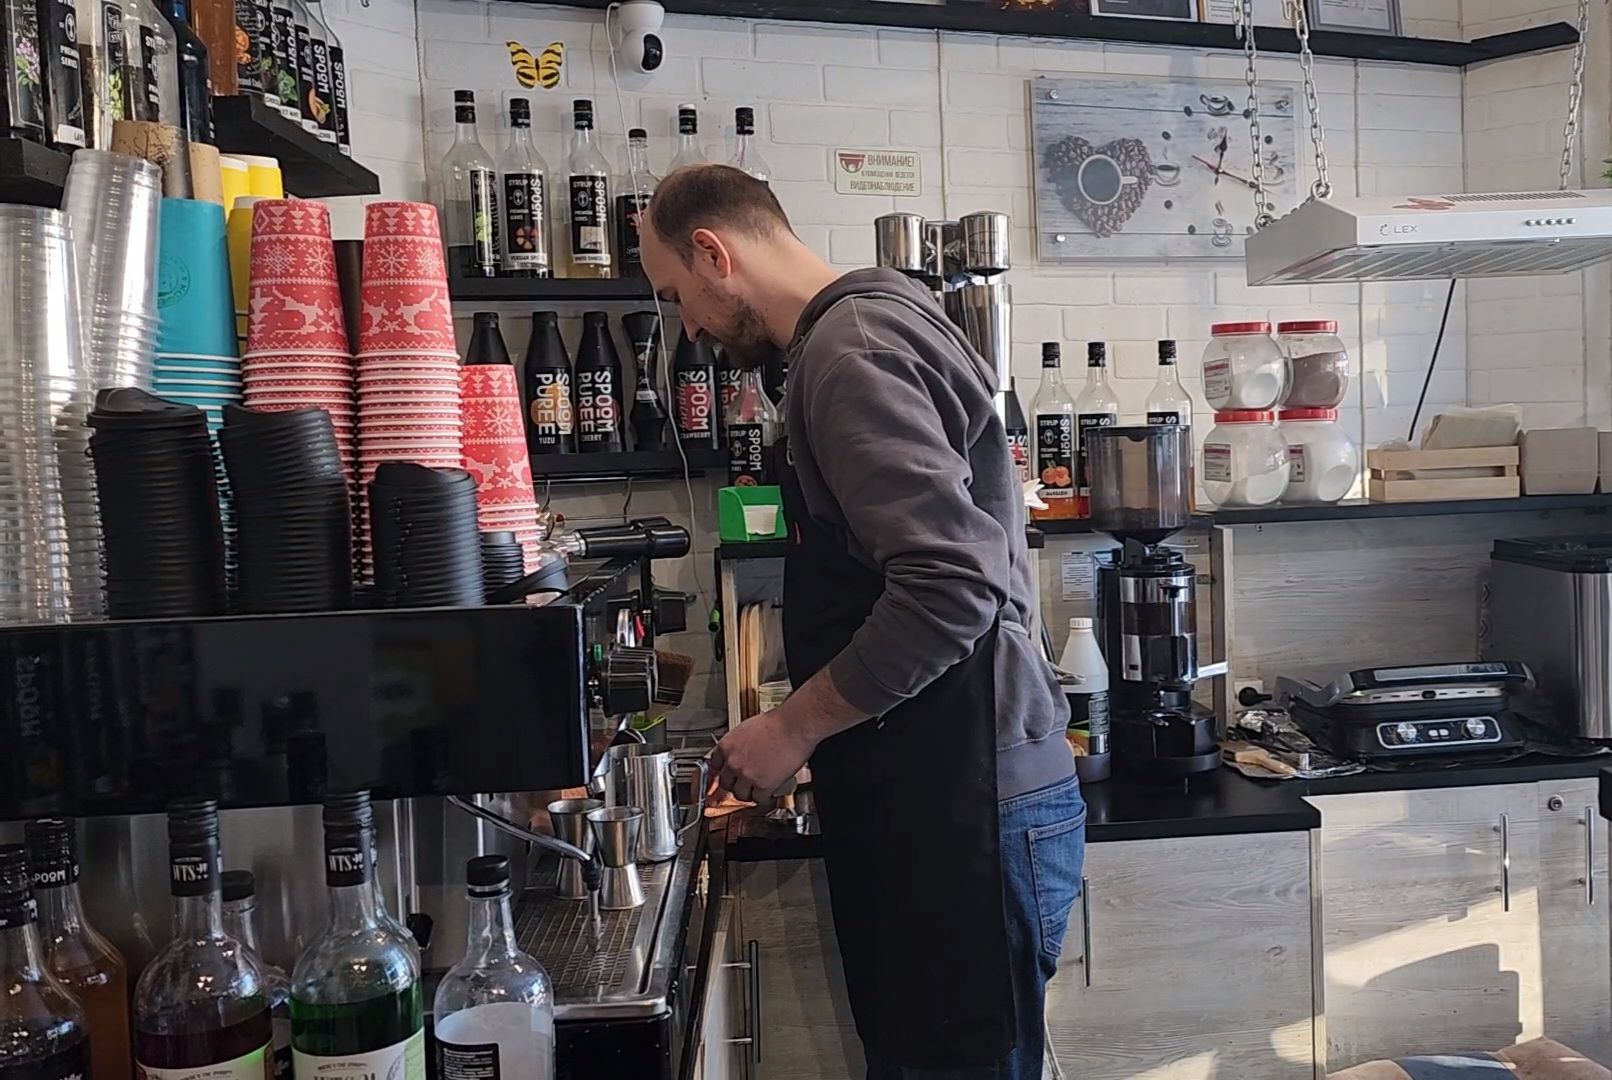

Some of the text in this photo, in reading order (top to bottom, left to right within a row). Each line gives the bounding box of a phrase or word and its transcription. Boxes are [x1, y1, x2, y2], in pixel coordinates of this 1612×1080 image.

[286, 16, 298, 70] SPOOM
[313, 45, 330, 93] SPOOM
[334, 62, 346, 109] SPOOM
[530, 178, 543, 221] SPOOM
[594, 180, 608, 222] SPOOM
[536, 373, 556, 435] PUREE
[556, 372, 572, 435] SPOOM
[578, 372, 595, 433] PUREE
[594, 370, 614, 432] SPOOM
[690, 370, 708, 430] SPOOM
[538, 437, 556, 445] YUZU
[749, 429, 762, 471] SPOOM
[1060, 419, 1071, 458] SPOOM
[33, 869, 66, 884] POOM
